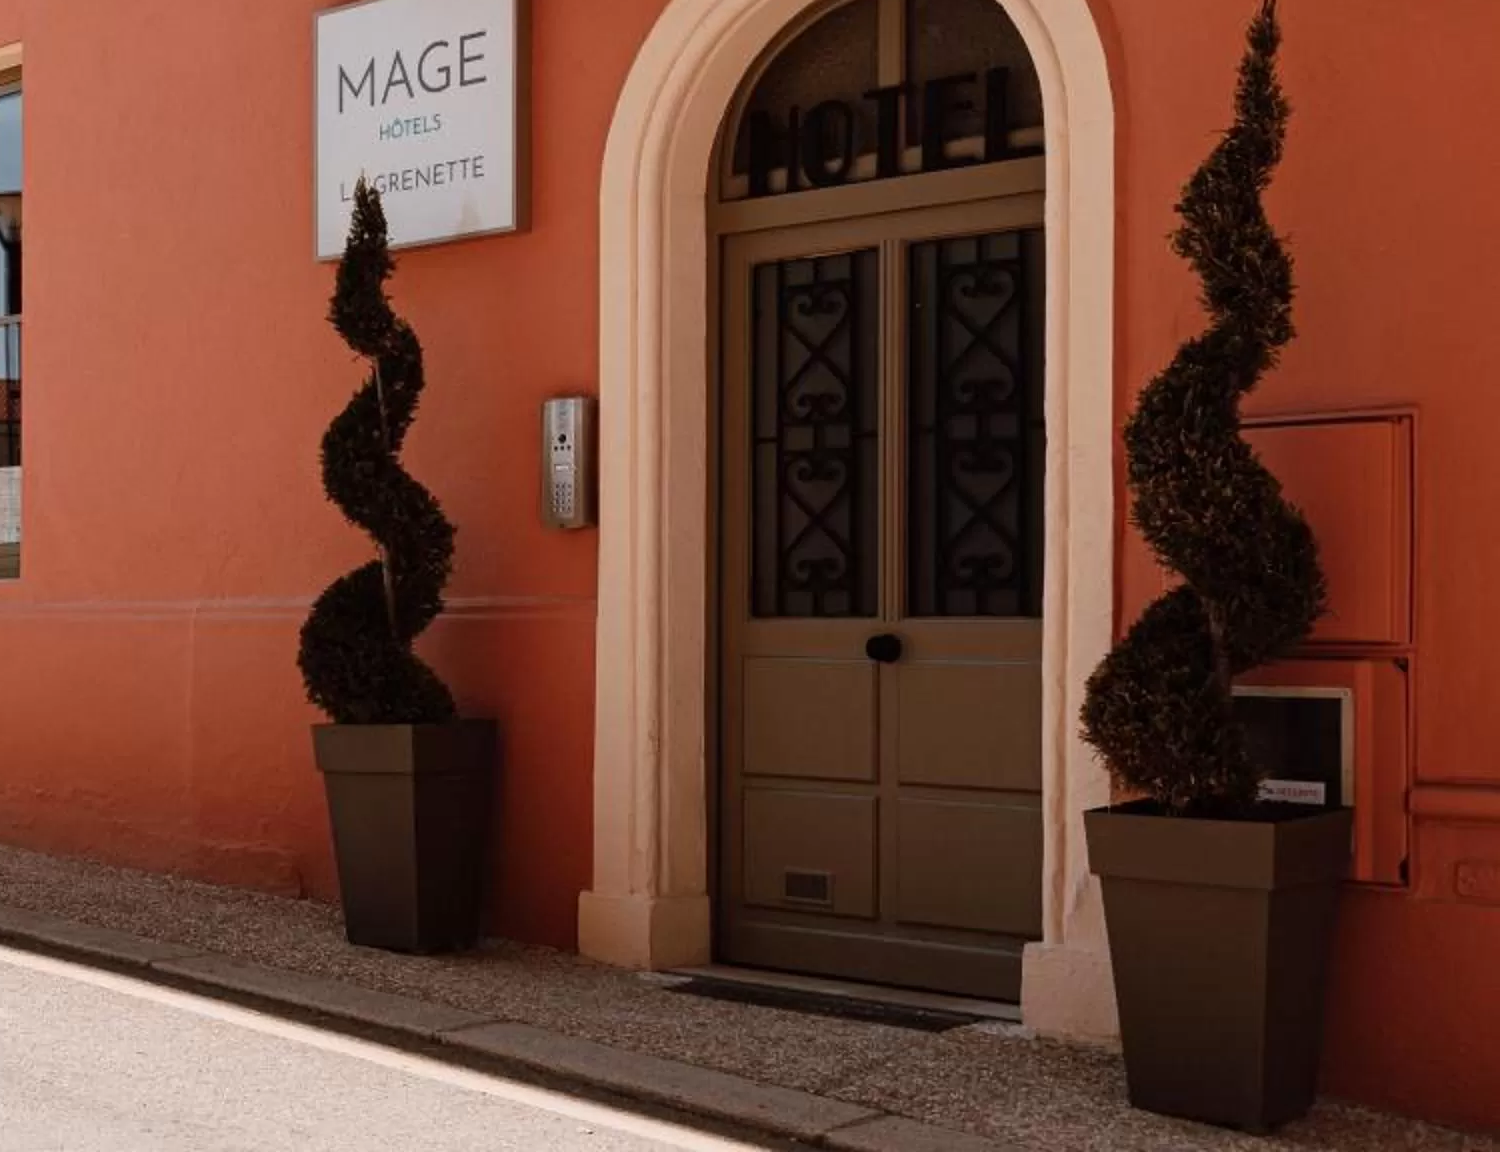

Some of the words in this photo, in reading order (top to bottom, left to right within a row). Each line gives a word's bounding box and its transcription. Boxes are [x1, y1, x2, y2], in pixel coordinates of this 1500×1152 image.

[338, 31, 487, 114] MAGE
[379, 113, 442, 141] HÔTELS
[748, 66, 1043, 197] HOTEL
[374, 155, 485, 196] GRENETTE
